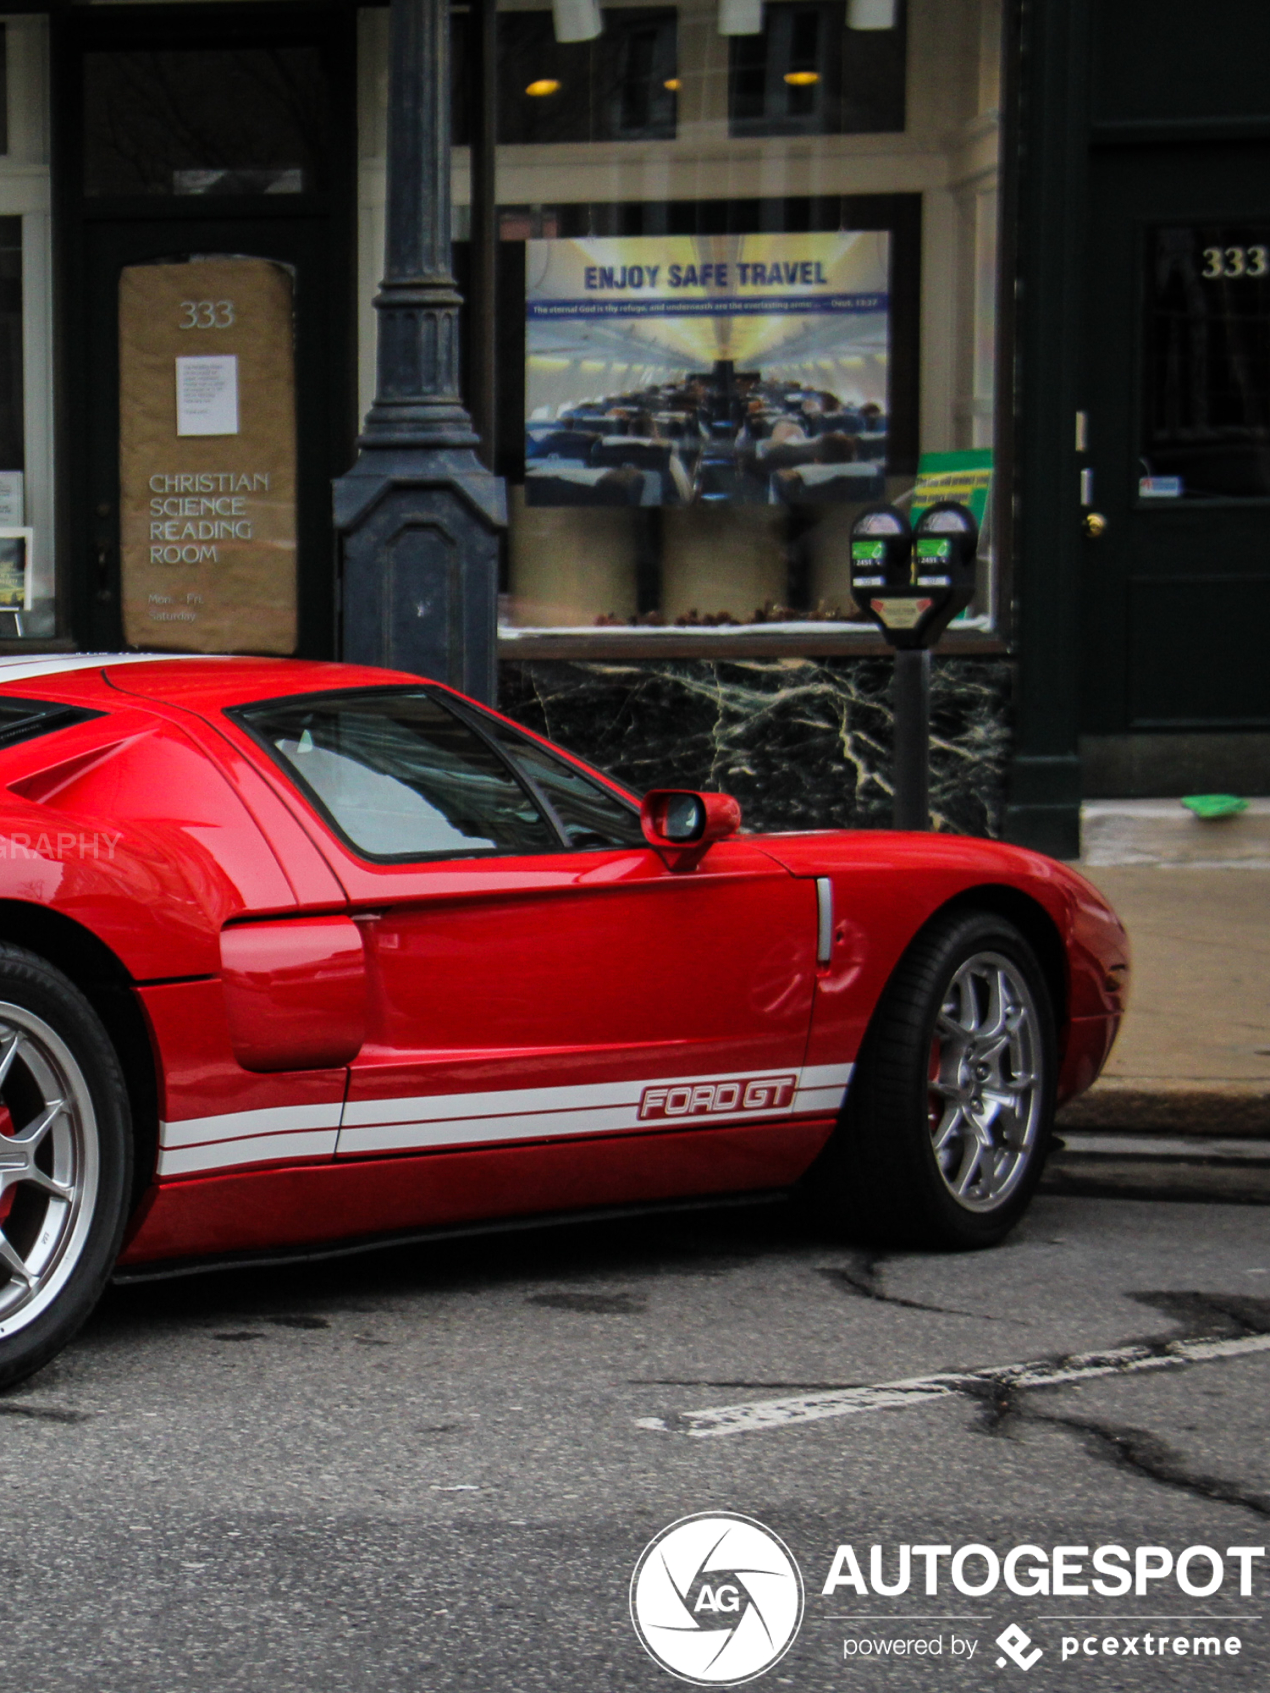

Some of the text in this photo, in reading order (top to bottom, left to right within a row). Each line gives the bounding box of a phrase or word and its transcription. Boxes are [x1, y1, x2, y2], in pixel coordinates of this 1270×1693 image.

[1202, 246, 1265, 278] 333
[584, 261, 827, 290] ENJOY SAFE TRAVEL
[179, 300, 234, 329] 333
[533, 306, 548, 314] The
[549, 305, 577, 314] eternal
[579, 305, 596, 313] God
[597, 305, 603, 313] is
[605, 304, 618, 315] thy
[649, 303, 665, 312] and
[666, 302, 713, 312] underneath
[729, 301, 743, 310] the
[743, 301, 789, 312] everlasting
[148, 473, 271, 493] CHRISTIAN
[149, 497, 247, 517] SCIENCE
[150, 520, 252, 540] READING
[150, 545, 219, 564] ROOM
[148, 611, 196, 623] Saturday
[640, 1077, 794, 1118] FORD GT
